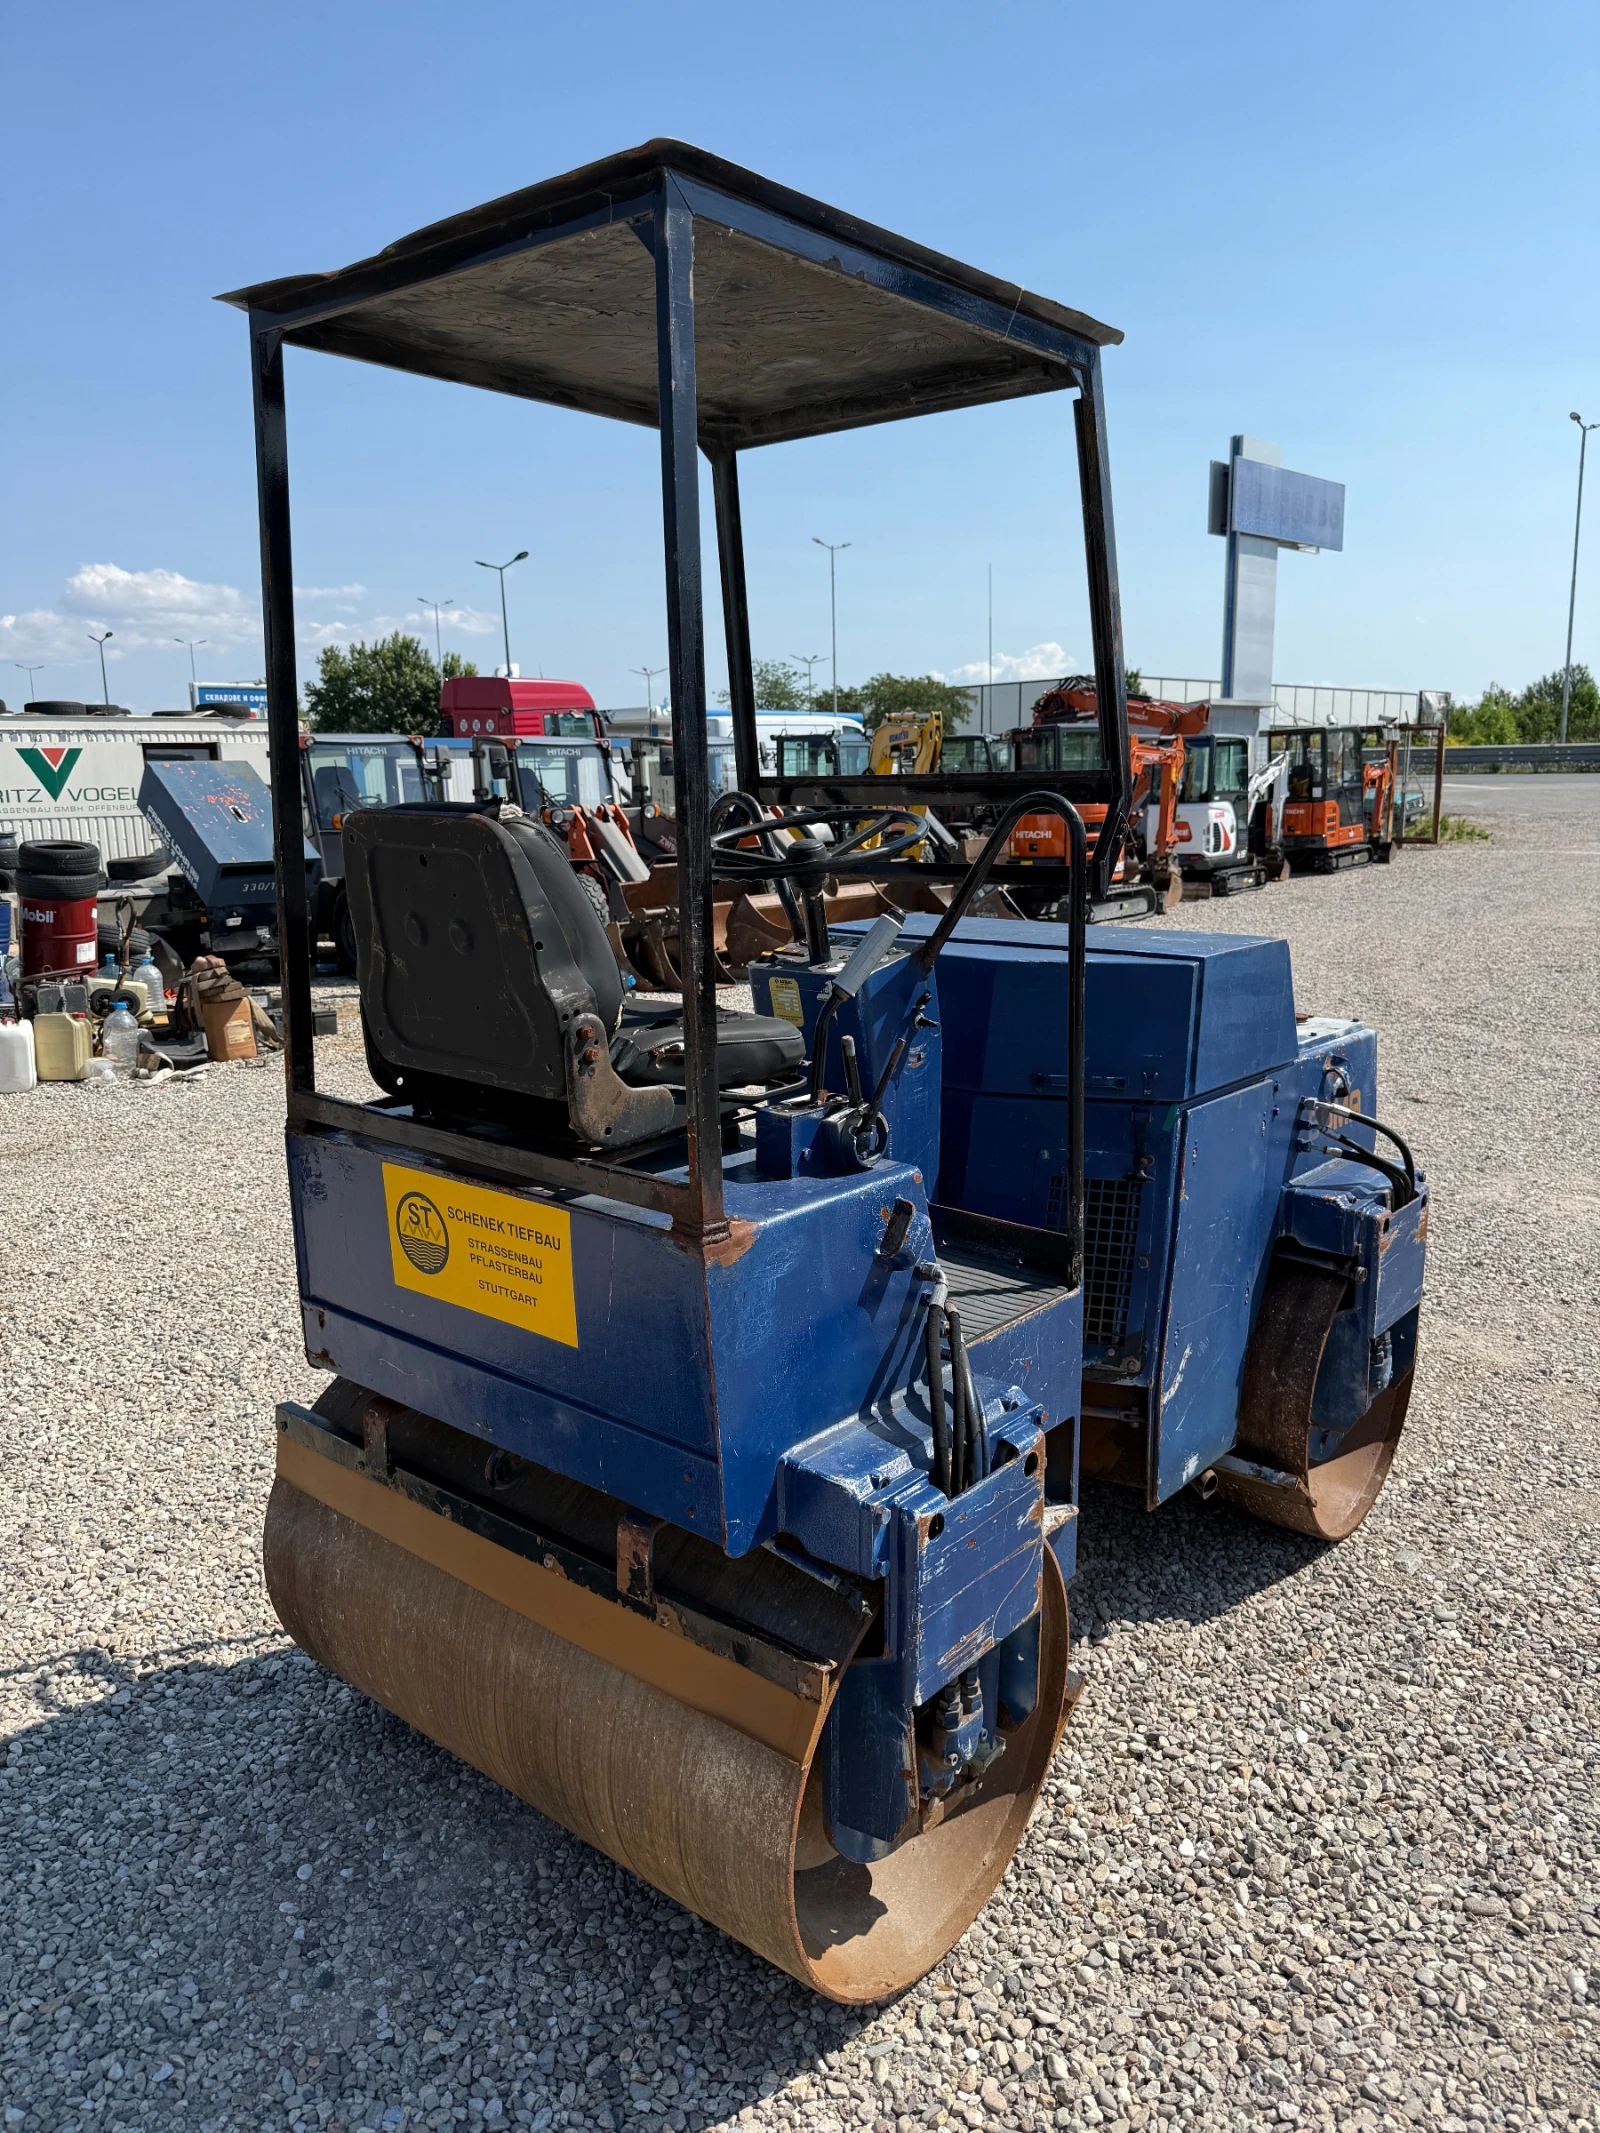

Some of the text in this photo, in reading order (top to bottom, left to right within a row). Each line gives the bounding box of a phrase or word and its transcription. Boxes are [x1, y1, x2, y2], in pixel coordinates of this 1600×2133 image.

[346, 747, 387, 755] HITACHI
[546, 748, 581, 756] HITACHI
[67, 787, 138, 802] VOGEL
[54, 805, 84, 813] GMBH
[1015, 831, 1052, 839] HITACHI
[21, 907, 54, 923] Mobil
[408, 1202, 432, 1229] ST
[447, 1206, 561, 1251] SCHENEK TIEFBAU
[468, 1238, 543, 1269] STRASSENBAU
[470, 1253, 543, 1285] PFLASTERBAU
[478, 1279, 538, 1308] STUTTGART
